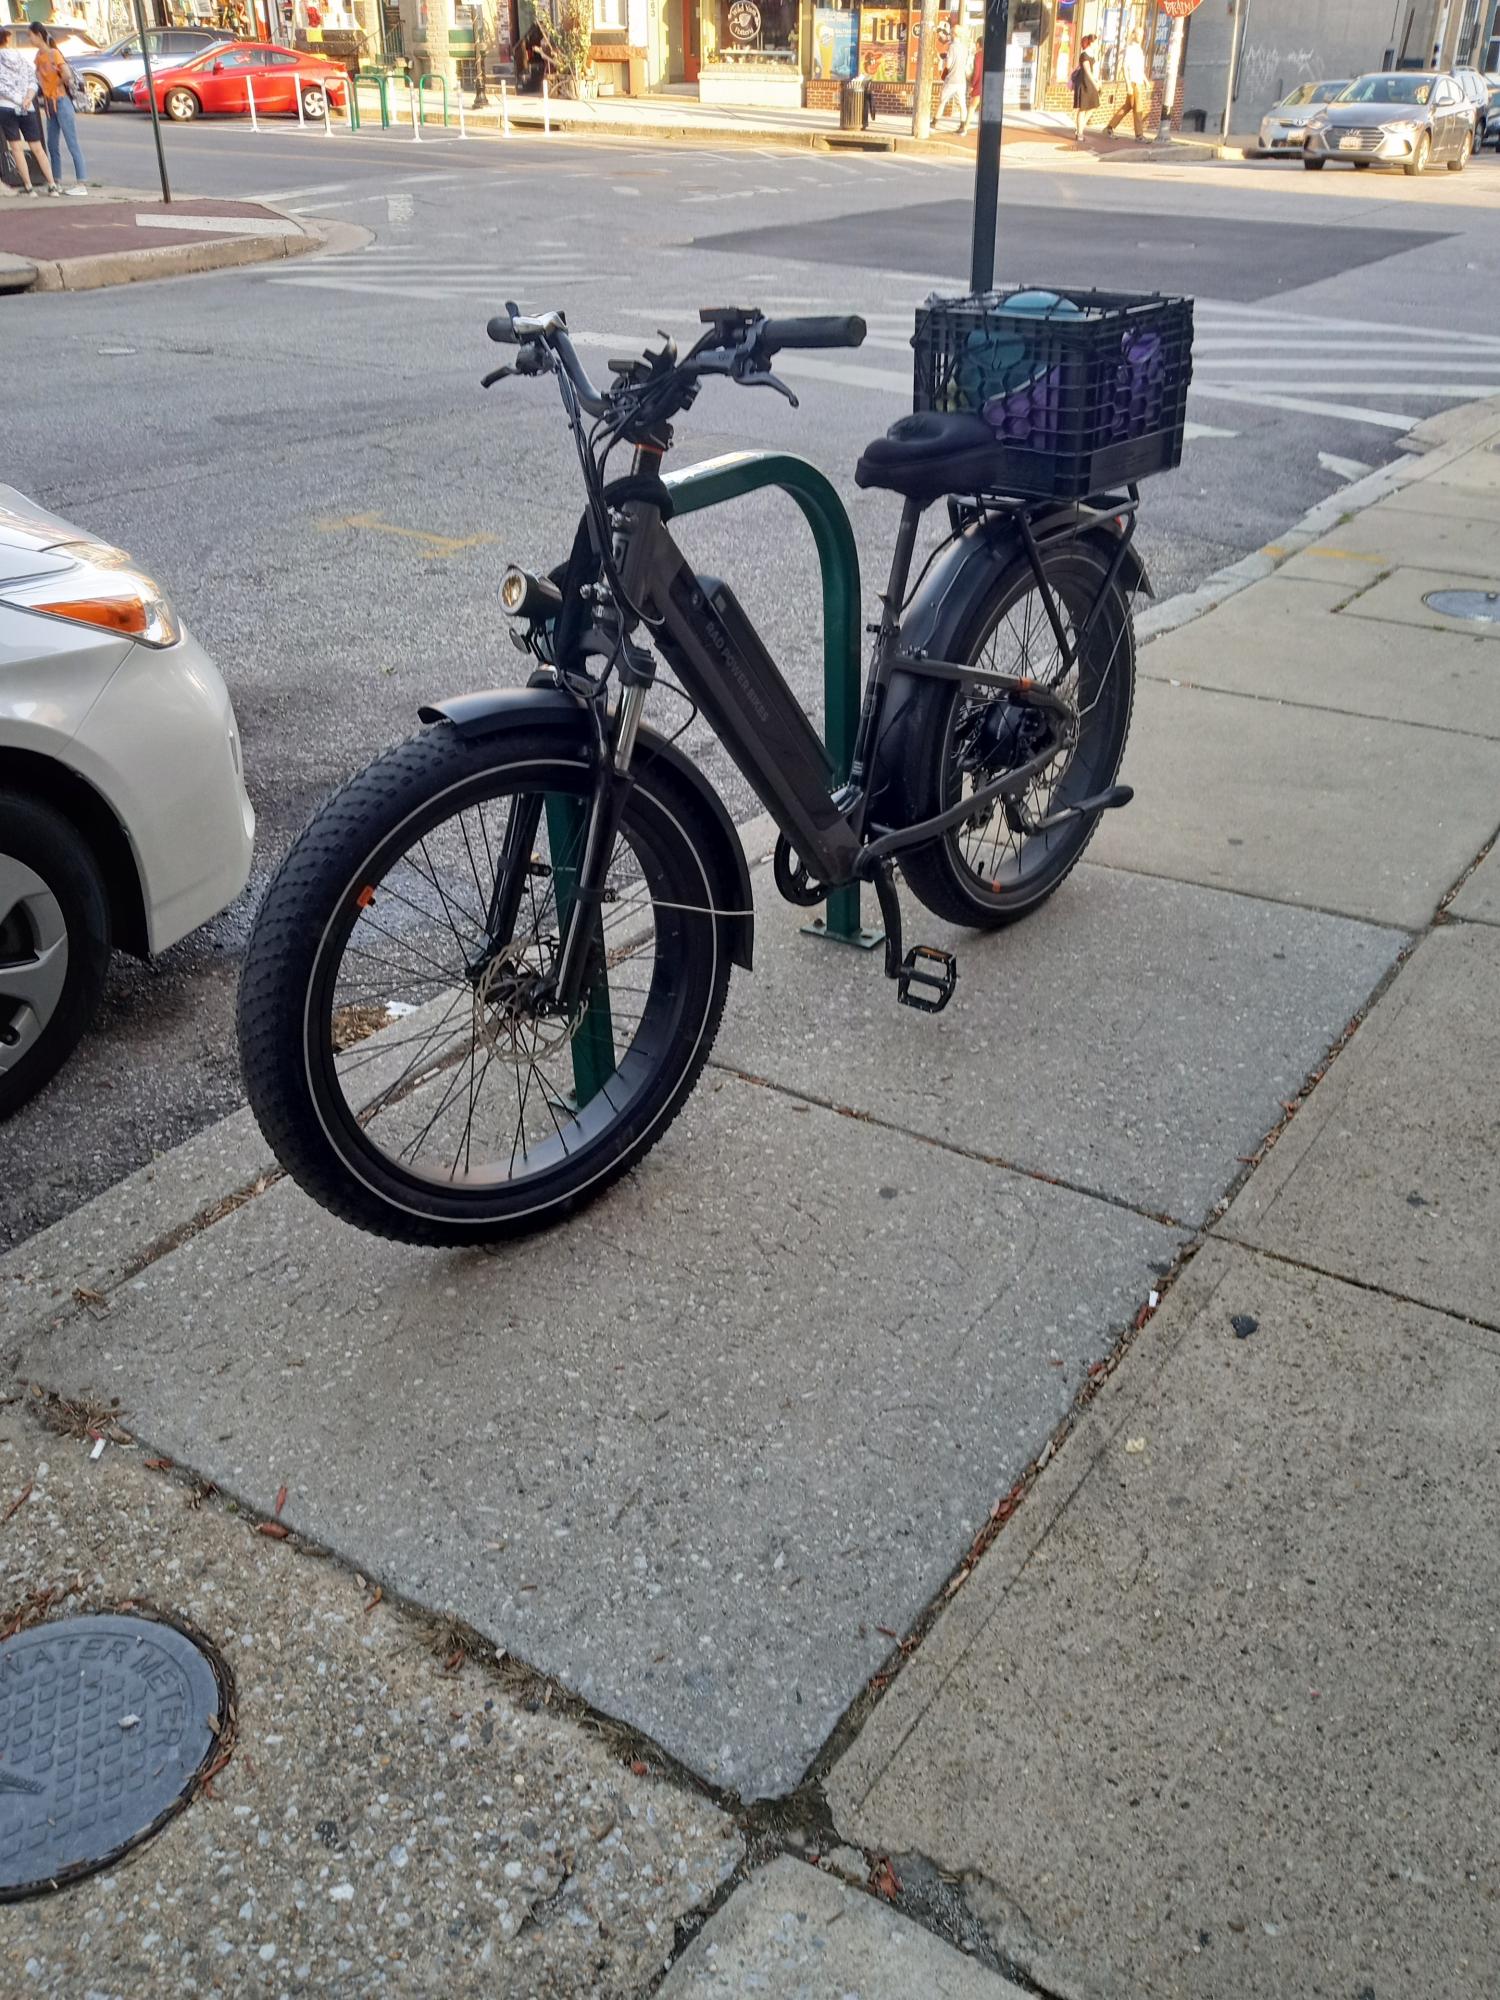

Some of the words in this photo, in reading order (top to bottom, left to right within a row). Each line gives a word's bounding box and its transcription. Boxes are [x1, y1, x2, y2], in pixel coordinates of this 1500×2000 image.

[705, 622, 725, 649] RAD
[721, 647, 750, 692] POWER
[747, 687, 769, 722] BIKES
[0, 1638, 129, 1684] WATER
[130, 1653, 187, 1749] METER
